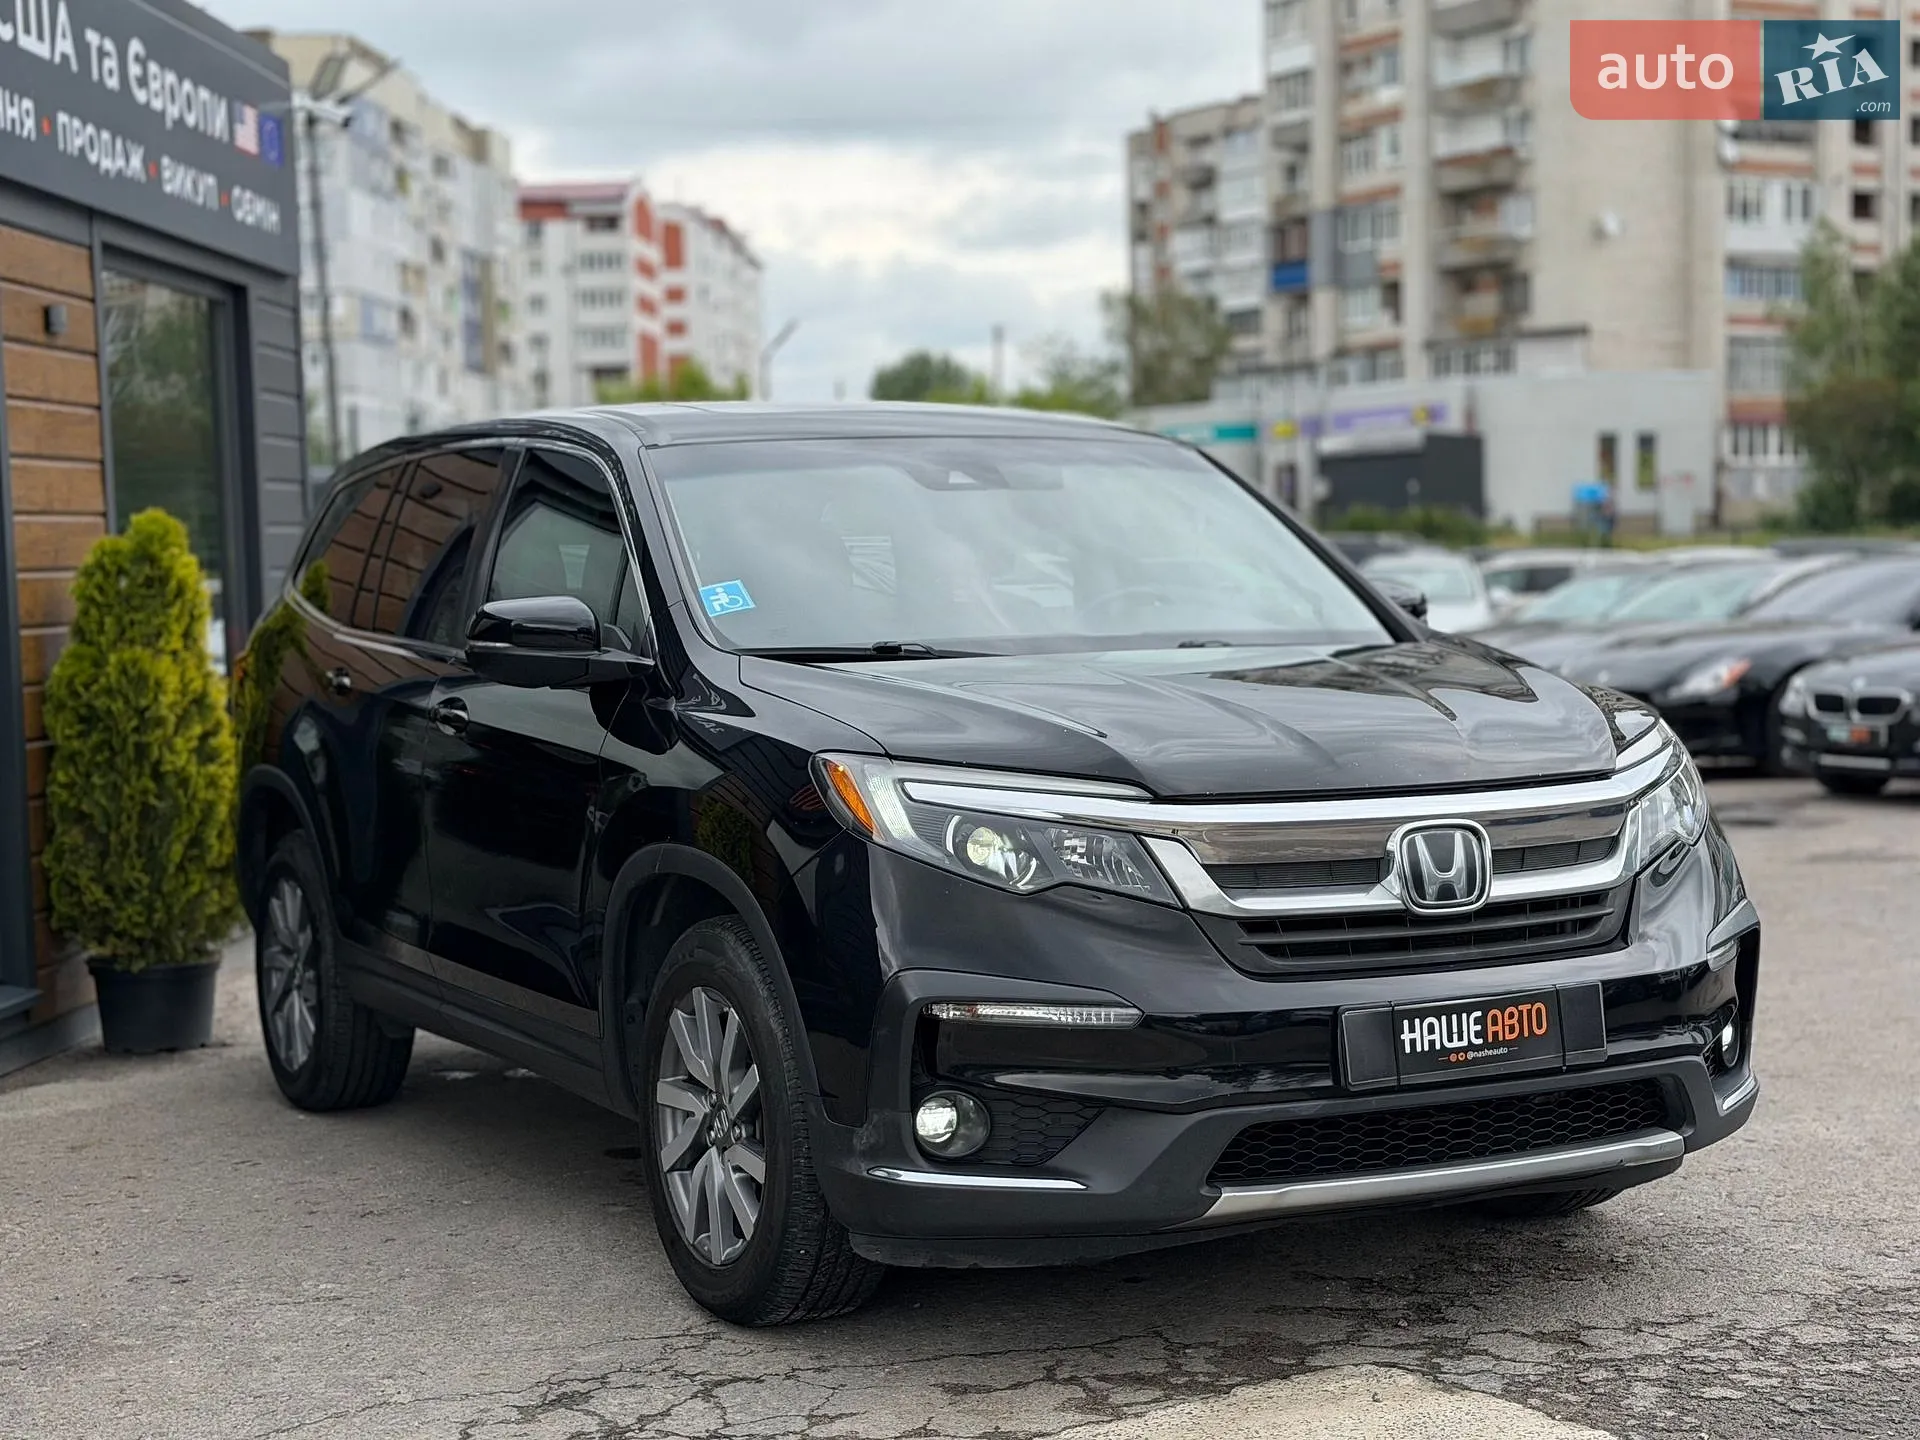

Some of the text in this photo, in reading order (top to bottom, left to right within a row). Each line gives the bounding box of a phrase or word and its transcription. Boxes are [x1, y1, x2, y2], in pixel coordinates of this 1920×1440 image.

[0, 0, 230, 143] ША та Європи
[56, 110, 147, 184] ПРОДАЖ
[160, 154, 220, 212] ВИКУП
[1400, 1001, 1548, 1054] НАШЕ АВТО
[1466, 1046, 1508, 1060] @nasheauto
